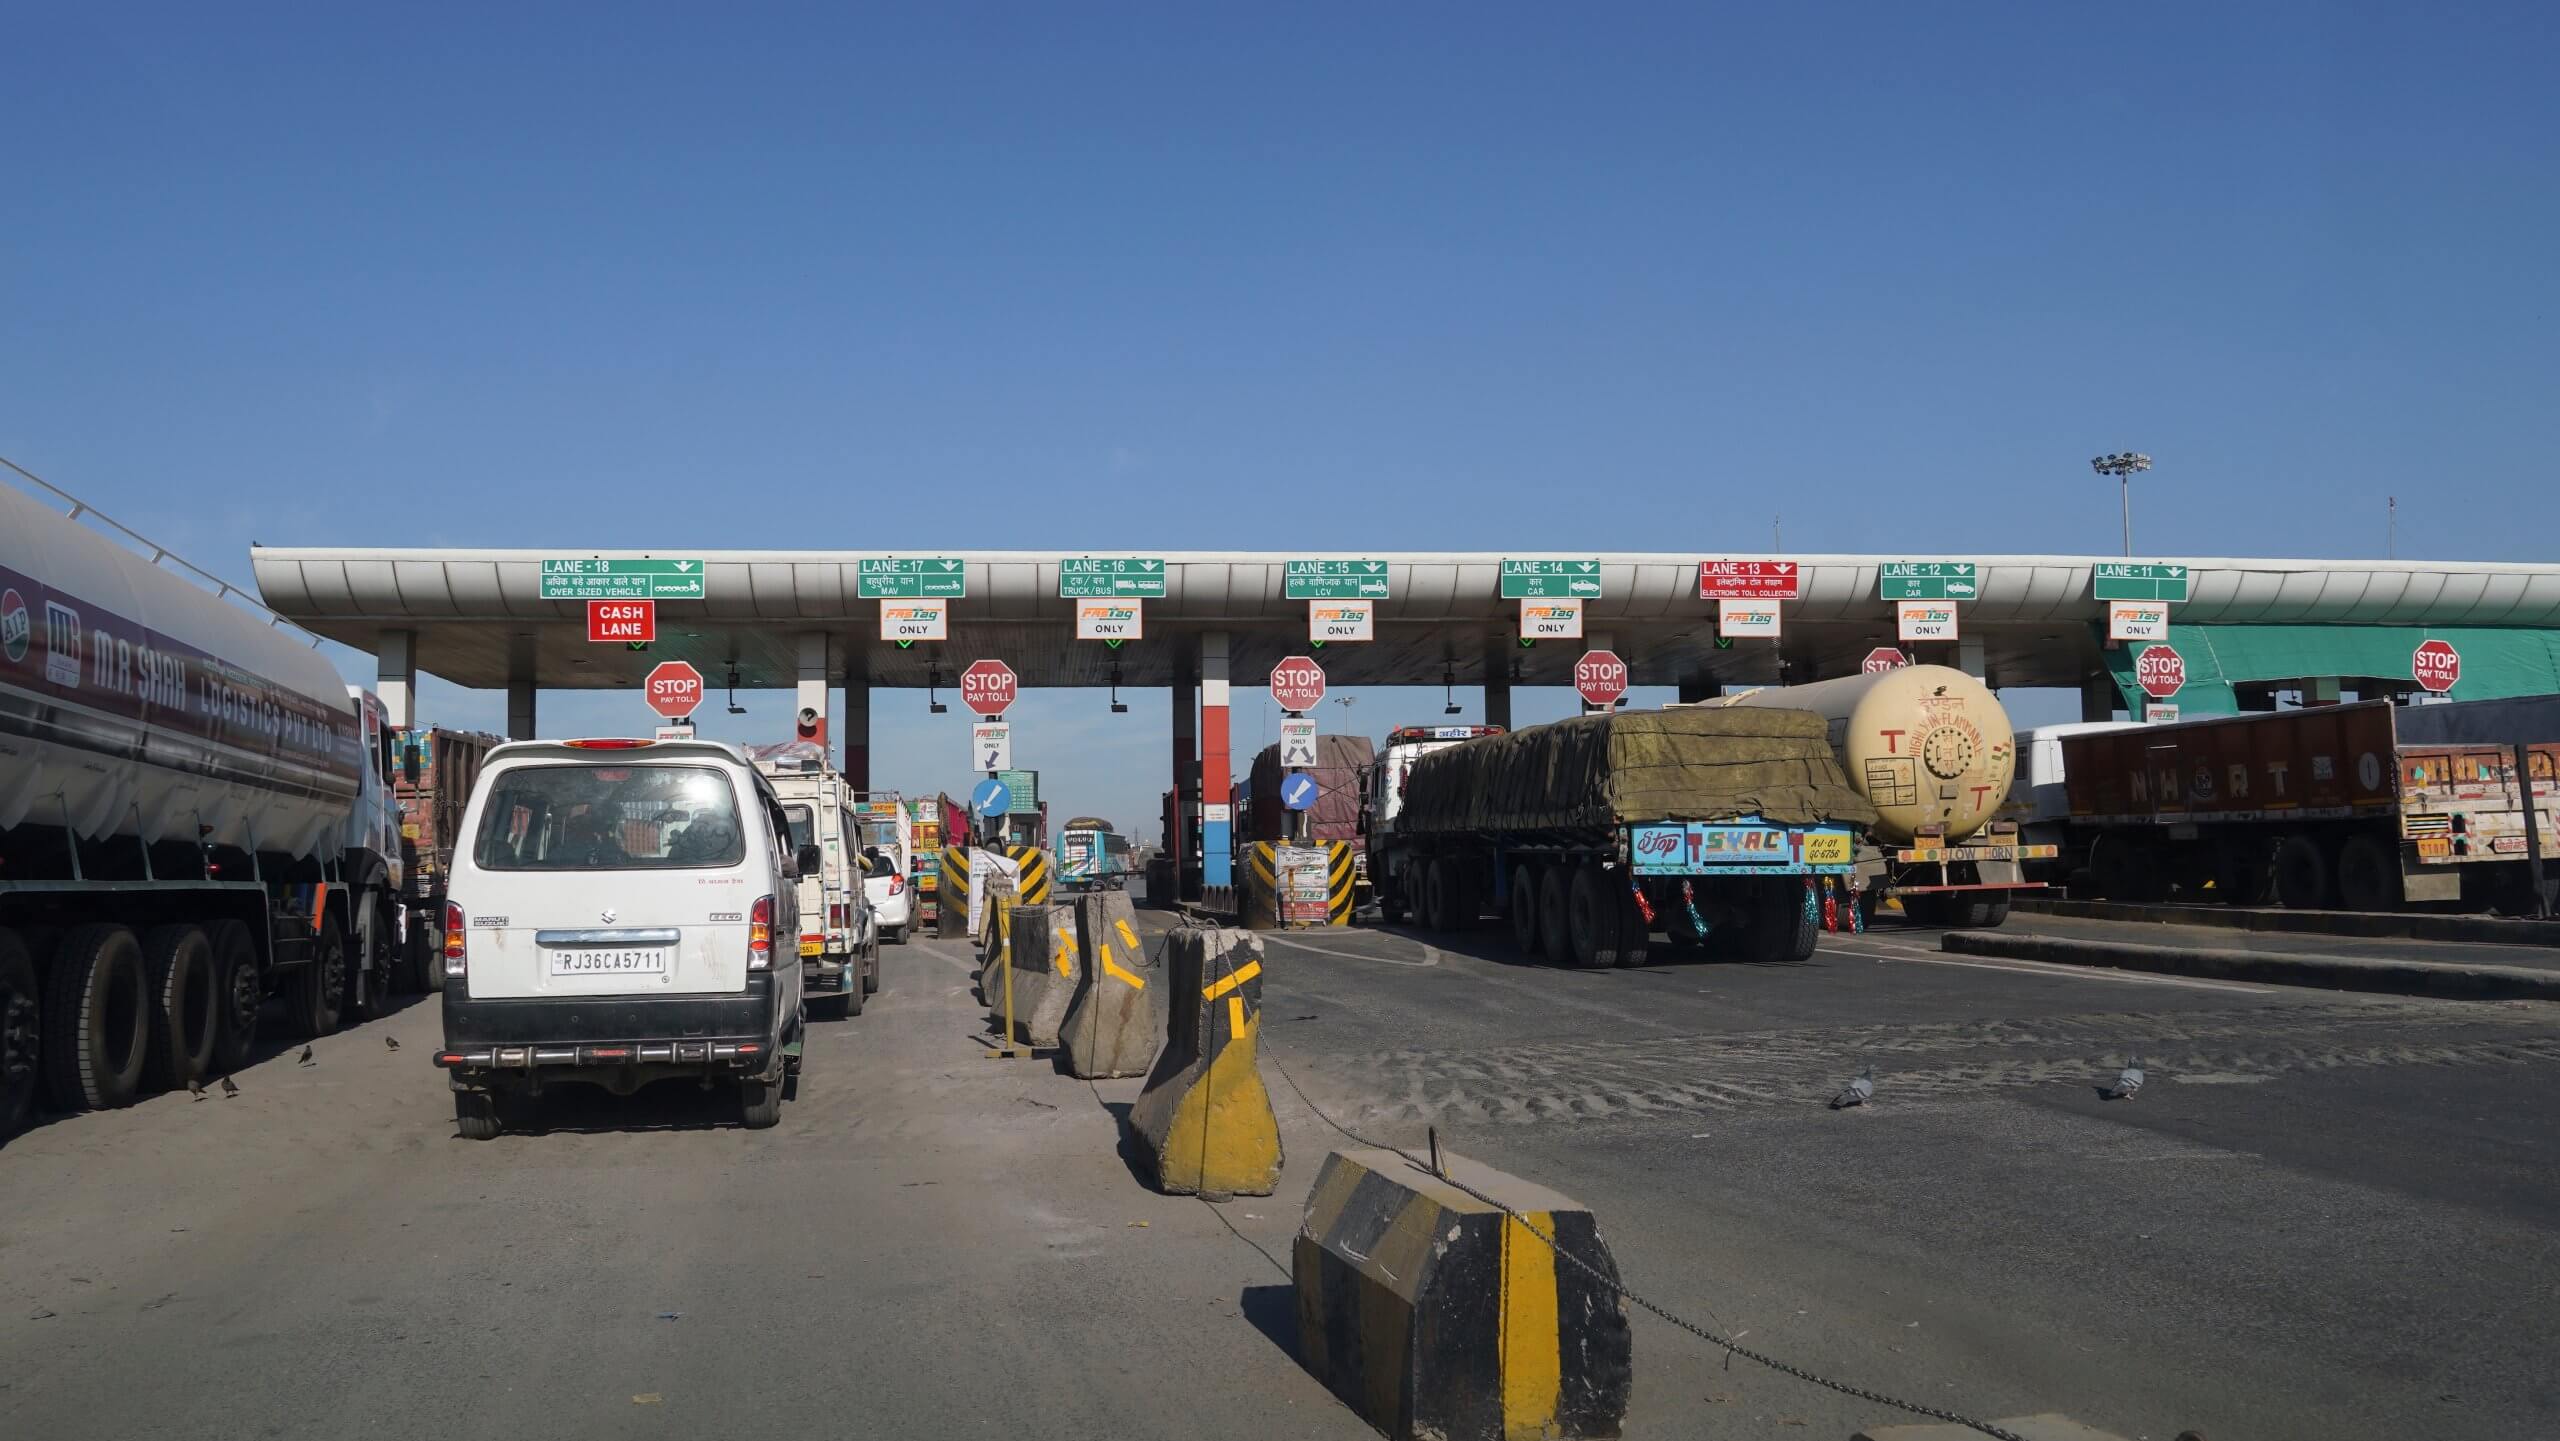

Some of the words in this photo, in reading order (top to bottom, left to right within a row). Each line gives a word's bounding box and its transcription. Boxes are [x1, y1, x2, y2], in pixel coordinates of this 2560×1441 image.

[544, 561, 583, 573] LANE
[595, 561, 609, 573] 18
[863, 560, 900, 572] LANE
[910, 560, 923, 572] 17
[1063, 560, 1100, 572] LANE
[1112, 560, 1125, 572] 16
[1289, 562, 1325, 574] LANE
[1336, 562, 1349, 574] 15
[1504, 562, 1540, 573] LANE
[1550, 562, 1564, 573] 14
[1703, 563, 1738, 575] LANE
[1747, 563, 1760, 575] 13
[1884, 564, 1918, 575] LANE
[1928, 564, 1941, 575] 12
[2098, 565, 2132, 577] LANE
[2141, 565, 2152, 577] 11
[550, 588, 573, 596] OVER
[577, 588, 602, 596] SIZED
[606, 588, 642, 596] VEHICLE
[1063, 587, 1112, 595] TRUCK/BUS
[1315, 588, 1332, 596] LCV
[1528, 588, 1544, 596] CAR
[600, 607, 643, 619] CASH
[601, 623, 642, 635] LANE
[900, 626, 928, 634] ONLY
[1095, 625, 1124, 633] ONLY
[1915, 626, 1941, 634] ONLY
[2126, 626, 2152, 634] ONLY
[2140, 657, 2180, 673] STOP
[2416, 651, 2457, 669] STOP
[1579, 663, 1622, 680] STOP
[2417, 669, 2432, 678] PAY
[2434, 669, 2455, 680] TOLL
[137, 645, 186, 712] SHAH
[965, 673, 1013, 691] STOP
[1275, 670, 1321, 687] STOP
[2142, 676, 2156, 685] PAY
[2160, 676, 2180, 684] TOLL
[653, 680, 697, 694] STOP
[1580, 682, 1597, 691] PAY
[1599, 682, 1622, 691] TOLL
[967, 693, 985, 702] PAY
[987, 693, 1011, 702] TOLL
[1276, 689, 1293, 698] PAY
[1296, 689, 1319, 698] TOLL
[201, 677, 280, 737] LOGISTICS
[285, 709, 308, 745] PVT
[312, 720, 332, 753] LTD
[1637, 830, 1681, 859] Stop
[1940, 847, 1976, 862] BLOW
[564, 952, 661, 969] RJ36CA5711
